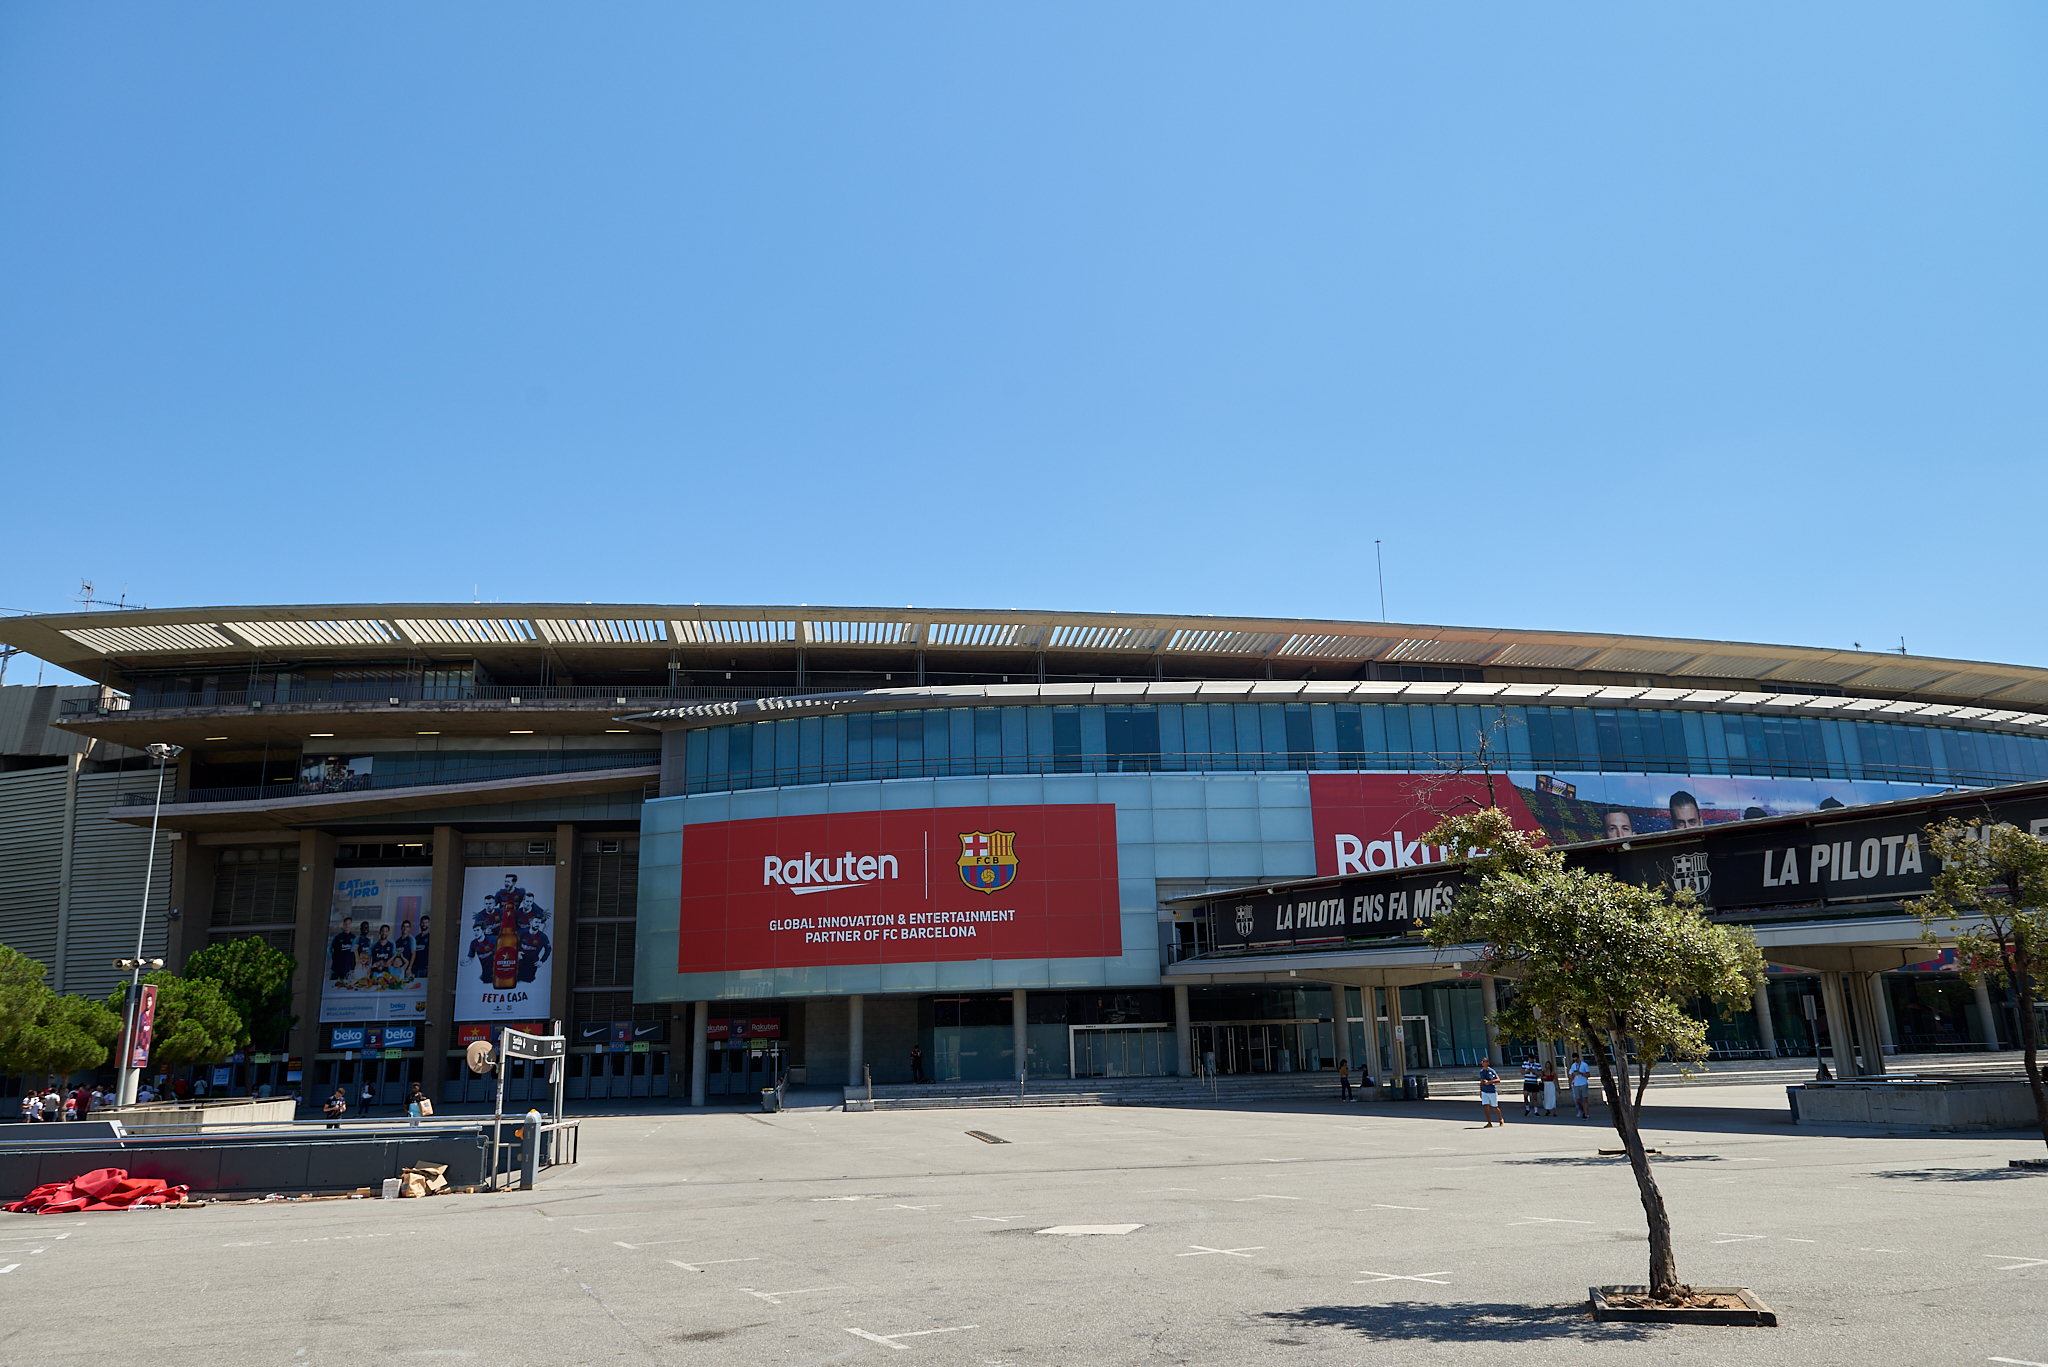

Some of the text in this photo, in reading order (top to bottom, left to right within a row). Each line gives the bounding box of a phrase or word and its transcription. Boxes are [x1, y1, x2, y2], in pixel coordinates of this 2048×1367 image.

[1763, 848, 1800, 887] LA
[1810, 833, 1923, 883] PILOTA
[764, 851, 898, 885] Rakuten
[338, 879, 361, 891] EAT
[353, 886, 379, 899] PRO
[1276, 881, 1453, 931] LA PILOTA ENS FA MÉS
[769, 910, 1015, 931] GLOBAL INNOVATION & ENTERTAINMENT
[805, 926, 977, 943] PARTNER OF FC BARCELONA
[482, 992, 528, 1003] FET A CASA
[334, 1030, 362, 1040] beko
[385, 1029, 414, 1039] beko
